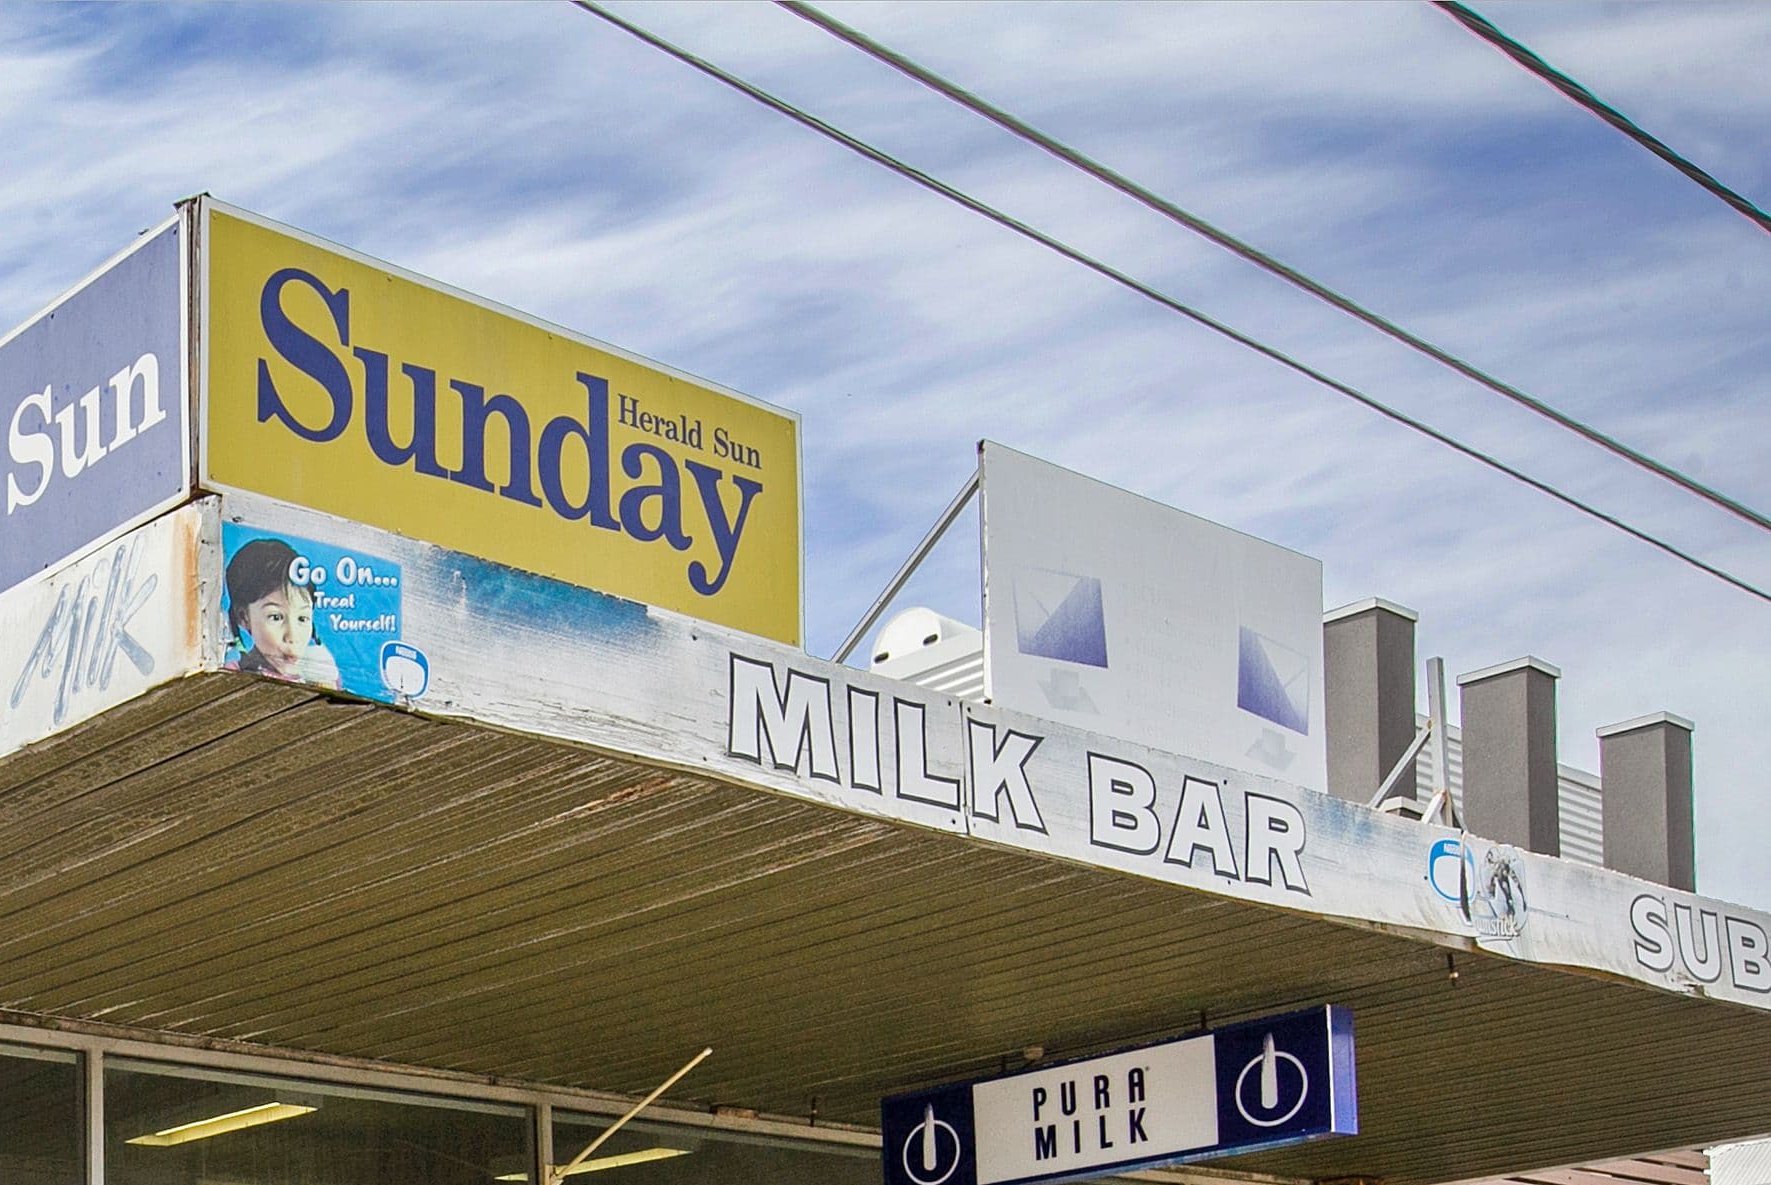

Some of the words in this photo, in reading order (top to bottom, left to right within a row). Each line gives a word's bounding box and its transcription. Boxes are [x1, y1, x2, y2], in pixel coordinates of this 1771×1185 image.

[5, 351, 167, 518] Sun
[256, 265, 764, 598] Sunday
[617, 392, 704, 453] Herald
[712, 424, 763, 471] Sun
[288, 556, 327, 586] Go
[335, 556, 399, 587] On...
[313, 590, 356, 609] Treat
[329, 613, 397, 633] Yourself!
[727, 652, 1049, 836] MILK
[1087, 751, 1312, 897] BAR
[1033, 1066, 1150, 1122] PURA
[1034, 1107, 1149, 1161] MILK
